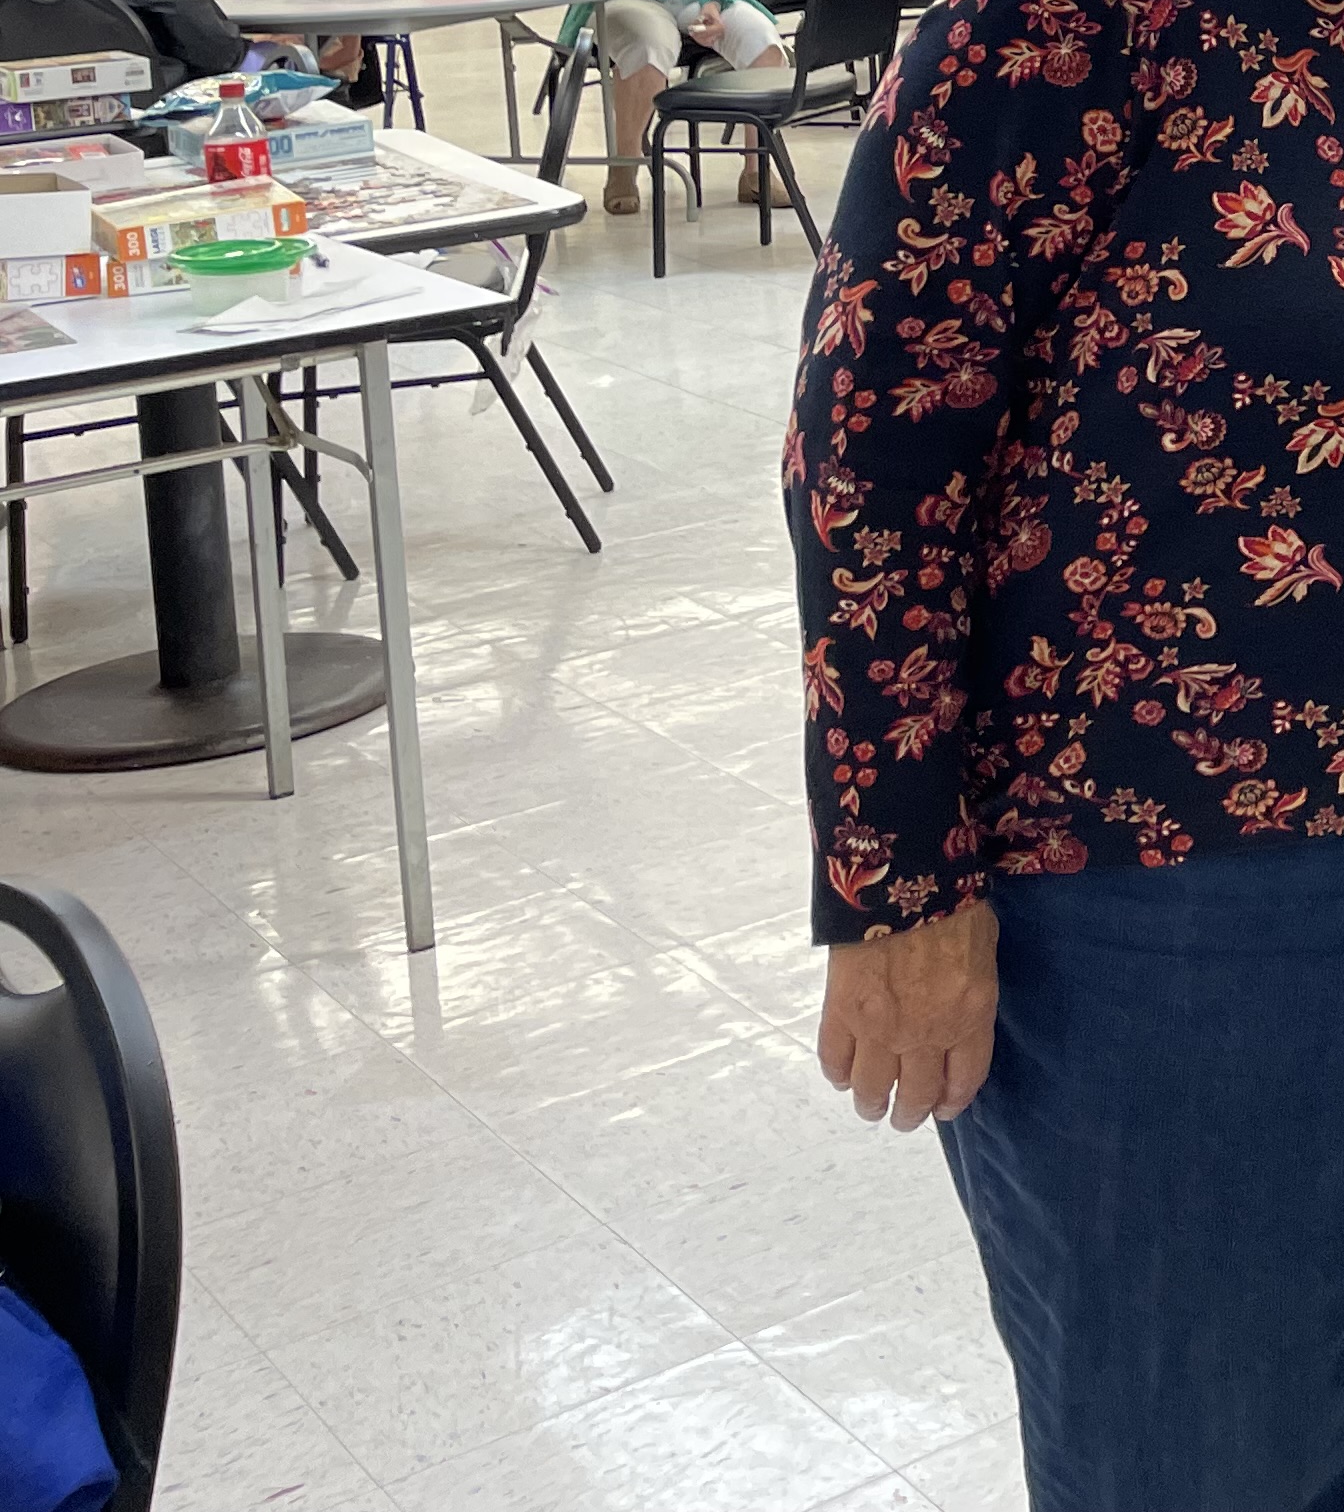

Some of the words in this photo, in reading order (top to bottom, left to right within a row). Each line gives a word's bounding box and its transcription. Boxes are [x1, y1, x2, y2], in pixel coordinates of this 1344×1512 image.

[269, 135, 293, 156] 00
[126, 231, 141, 257] 300
[112, 266, 126, 291] 300
